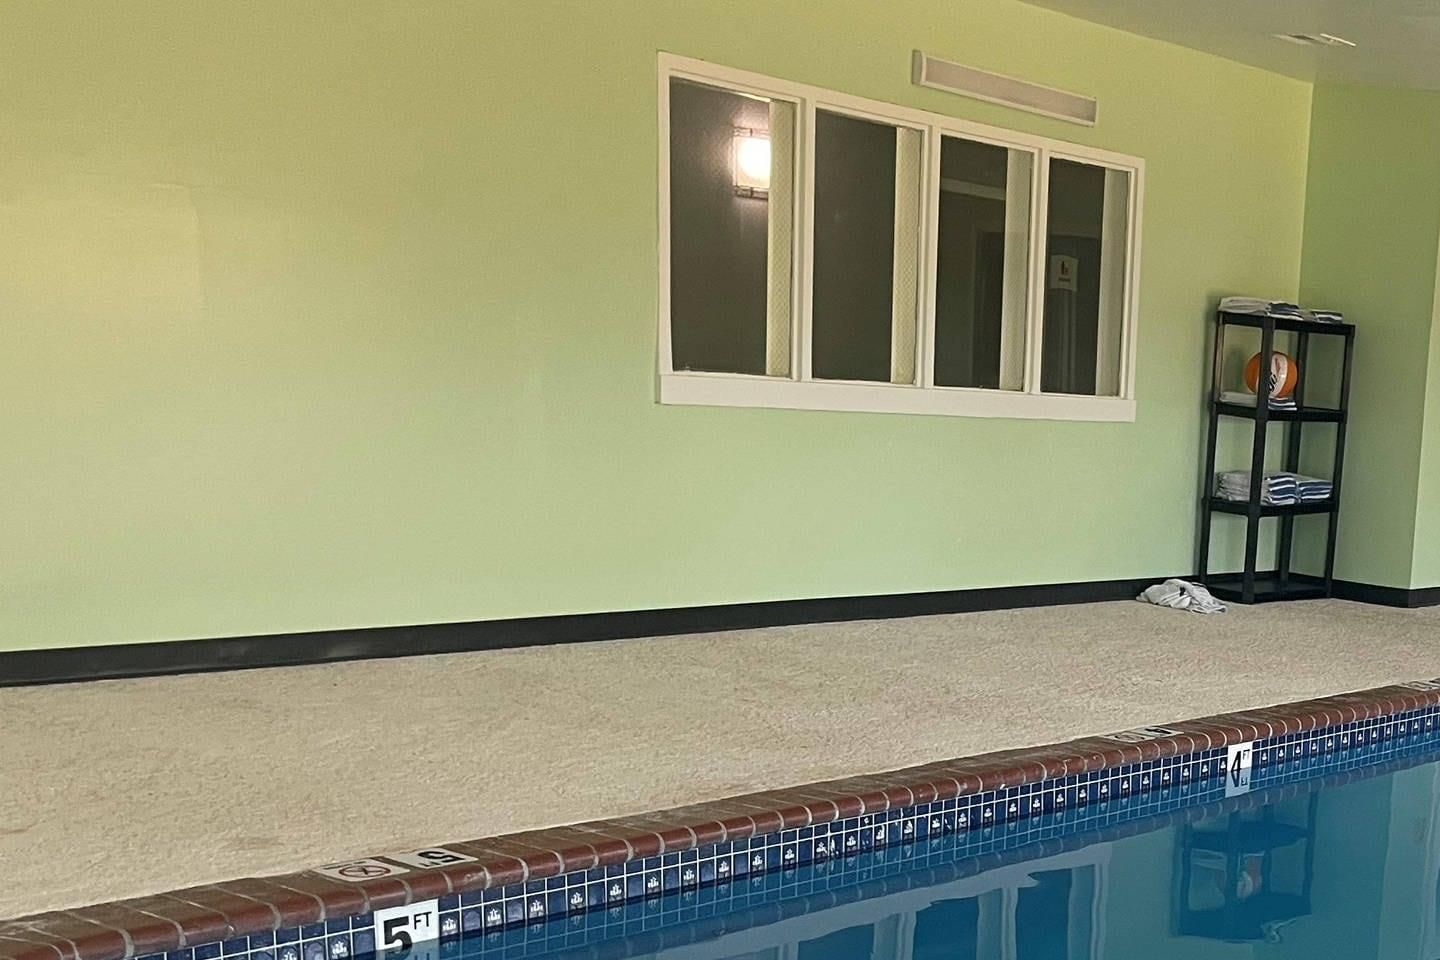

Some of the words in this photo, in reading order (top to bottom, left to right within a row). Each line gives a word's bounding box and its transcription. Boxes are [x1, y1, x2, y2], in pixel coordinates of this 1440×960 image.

[1231, 750, 1242, 772] 4
[417, 850, 465, 863] 5
[384, 915, 413, 949] 5
[414, 911, 432, 930] FT
